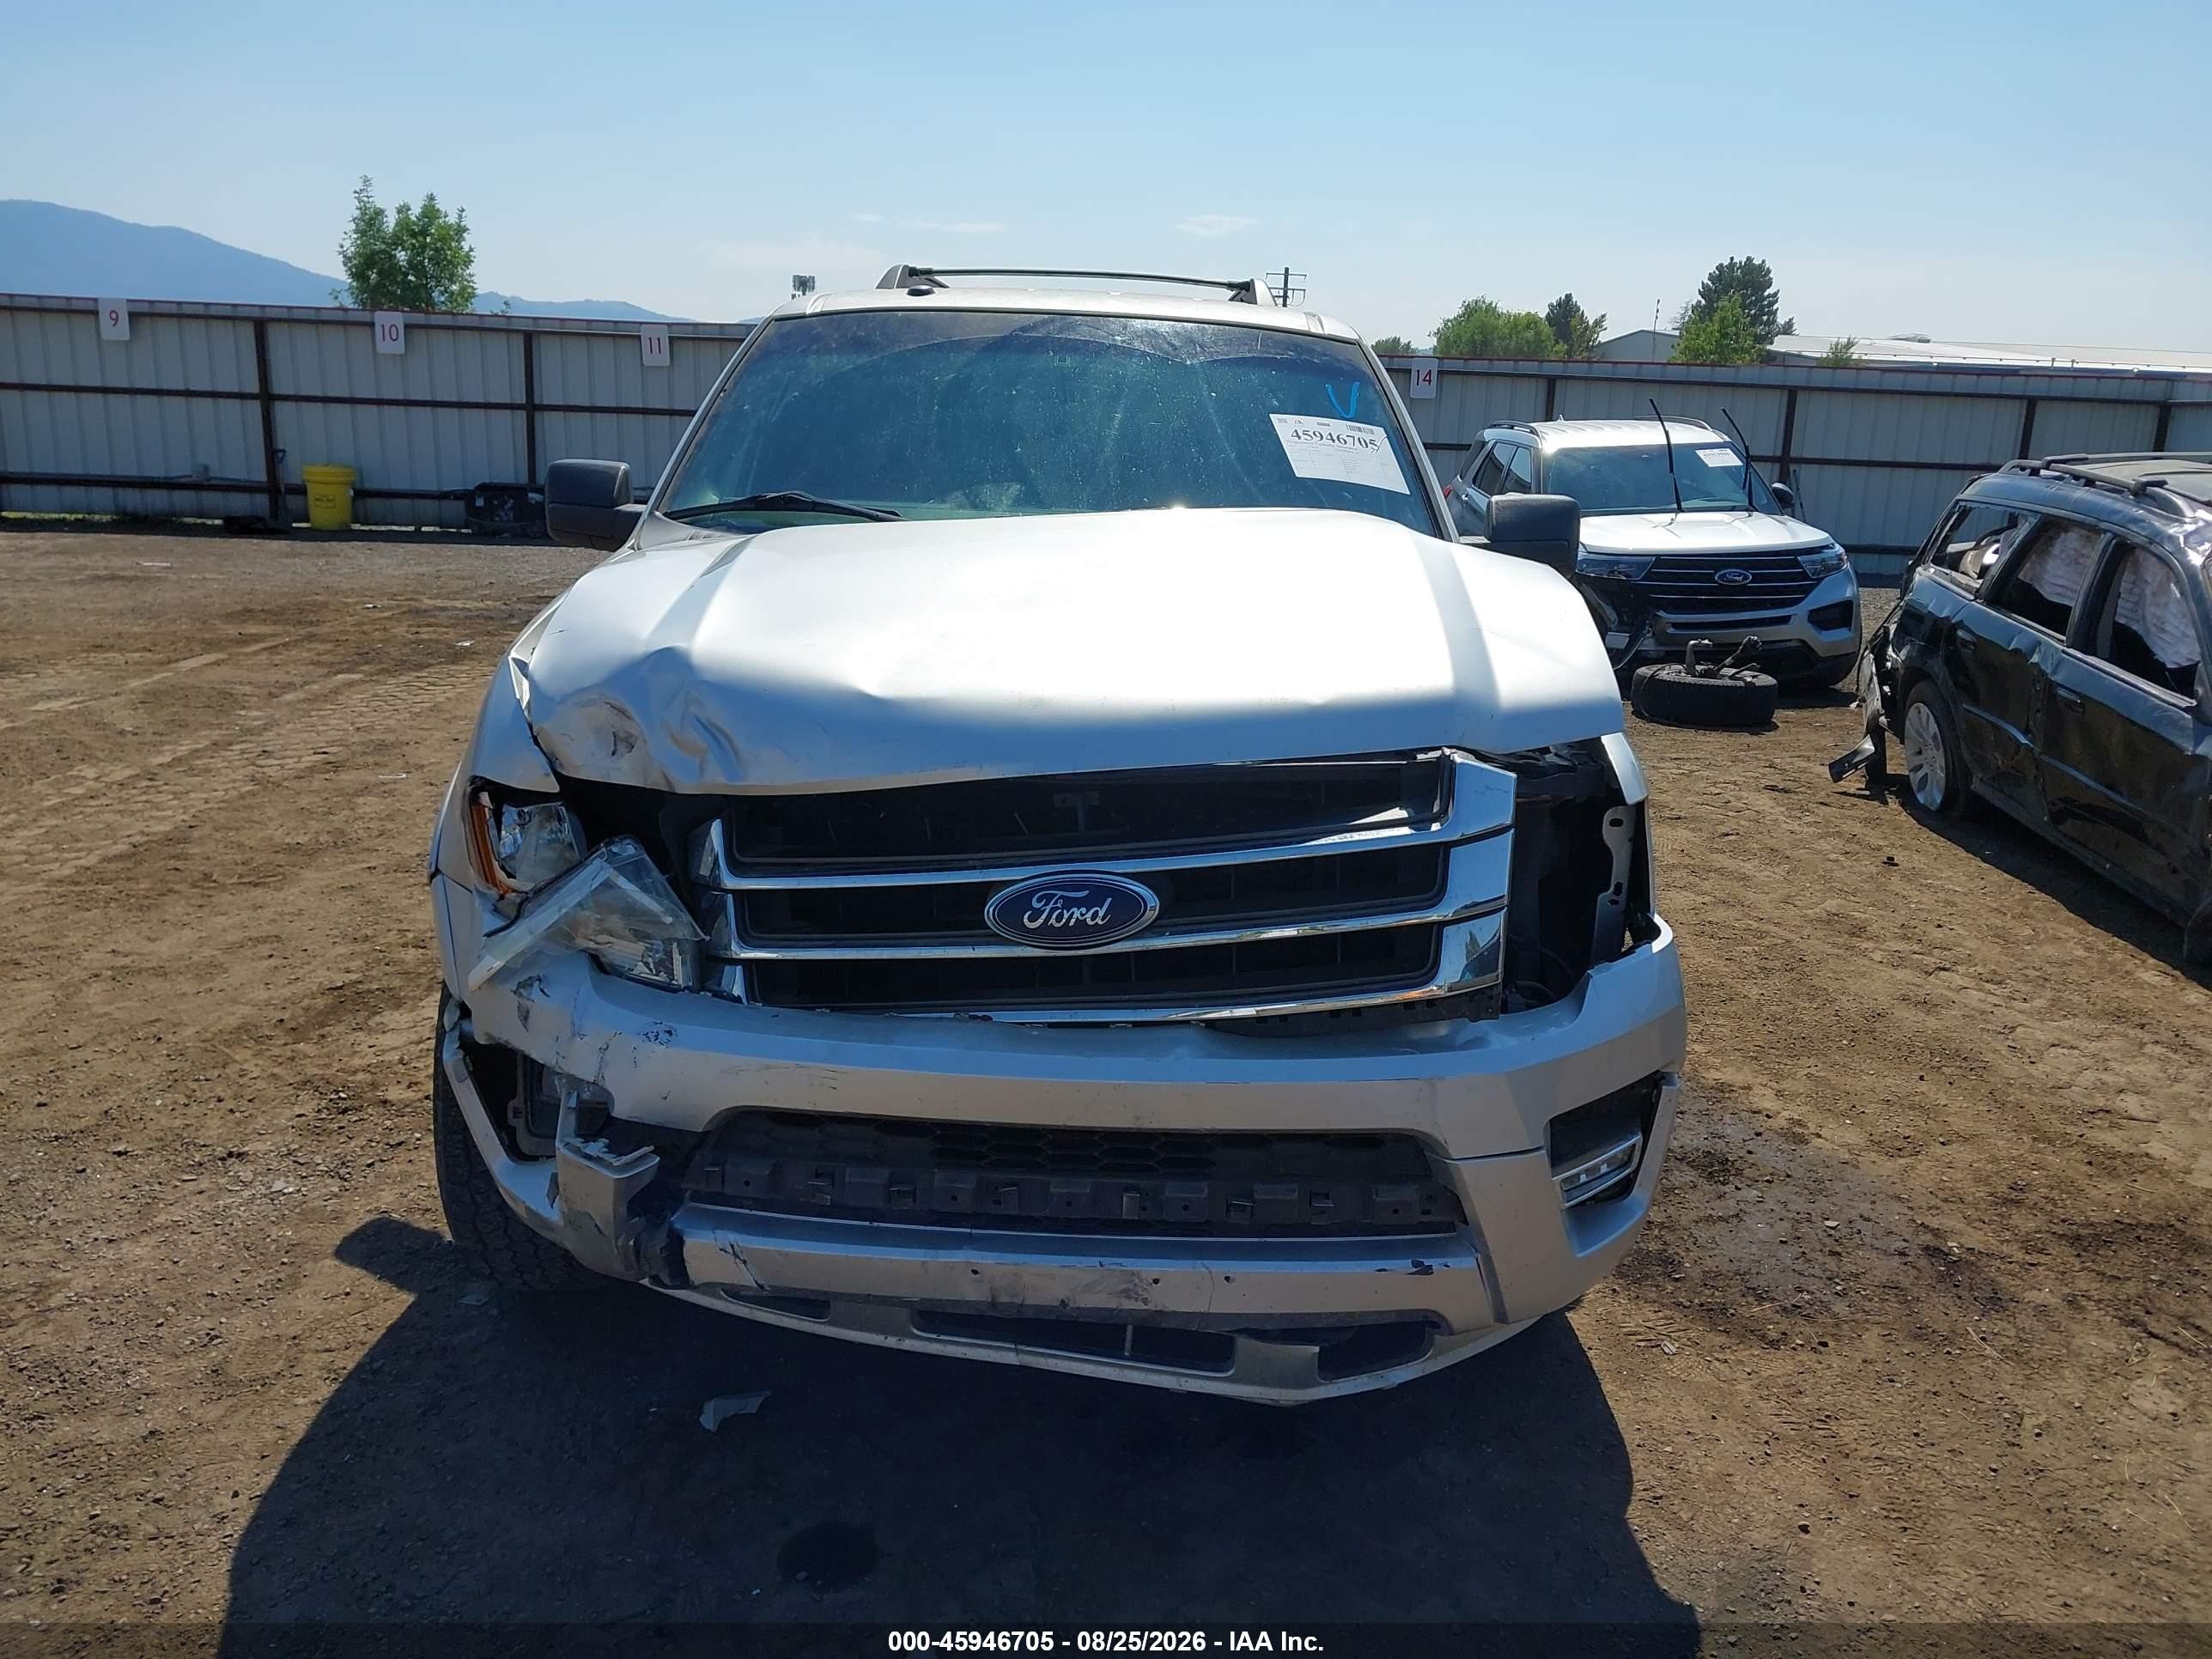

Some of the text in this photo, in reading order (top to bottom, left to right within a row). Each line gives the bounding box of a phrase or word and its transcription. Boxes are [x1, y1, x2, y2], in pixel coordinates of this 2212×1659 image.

[109, 310, 118, 327] 9
[380, 324, 399, 342] 10
[647, 337, 661, 355] 11
[1416, 369, 1432, 386] 14
[1291, 428, 1379, 452] 45946705
[1024, 890, 1112, 929] Ford
